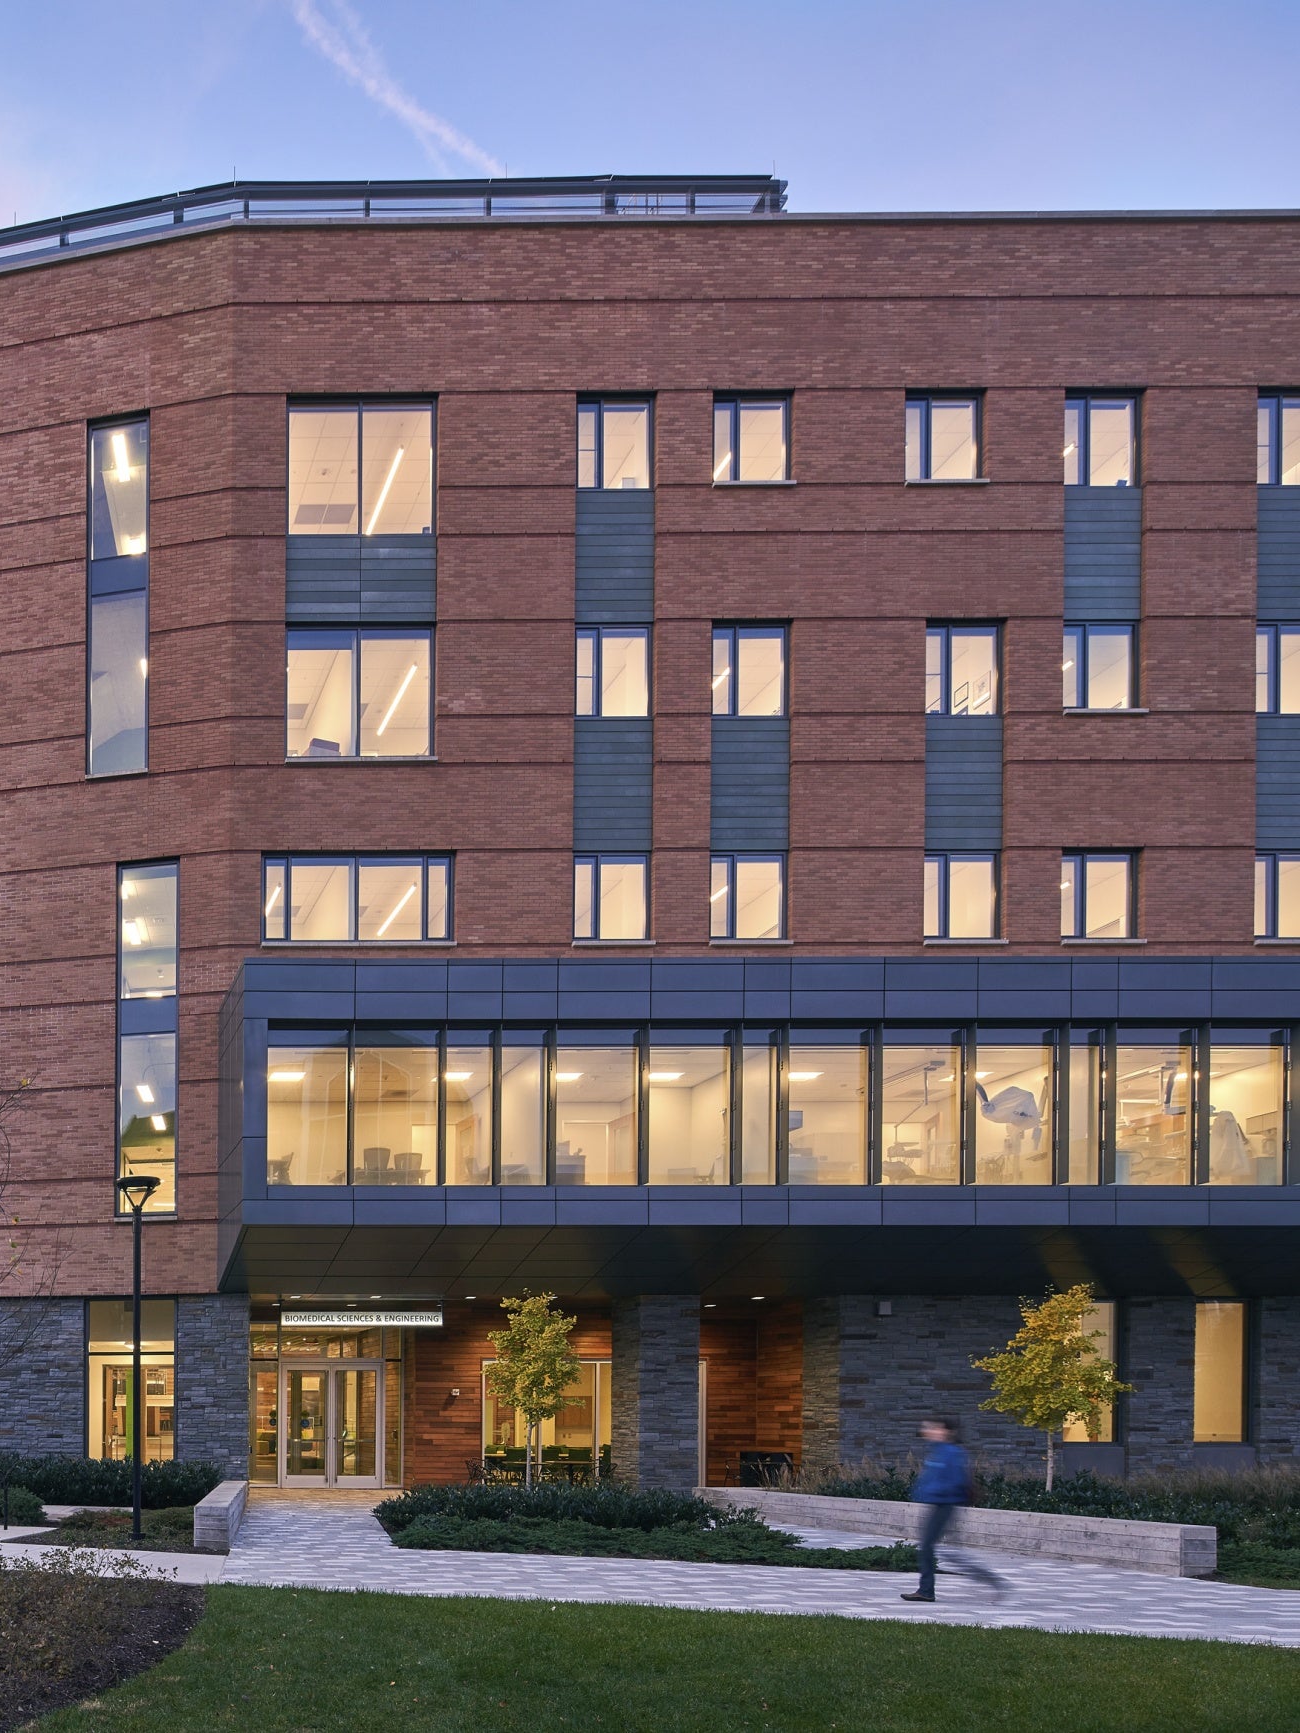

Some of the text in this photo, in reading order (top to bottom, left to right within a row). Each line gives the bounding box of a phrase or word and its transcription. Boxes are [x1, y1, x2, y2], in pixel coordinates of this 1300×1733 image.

[285, 1315, 439, 1323] BIOMEDICAL SCIENCES & ENGINEERING
